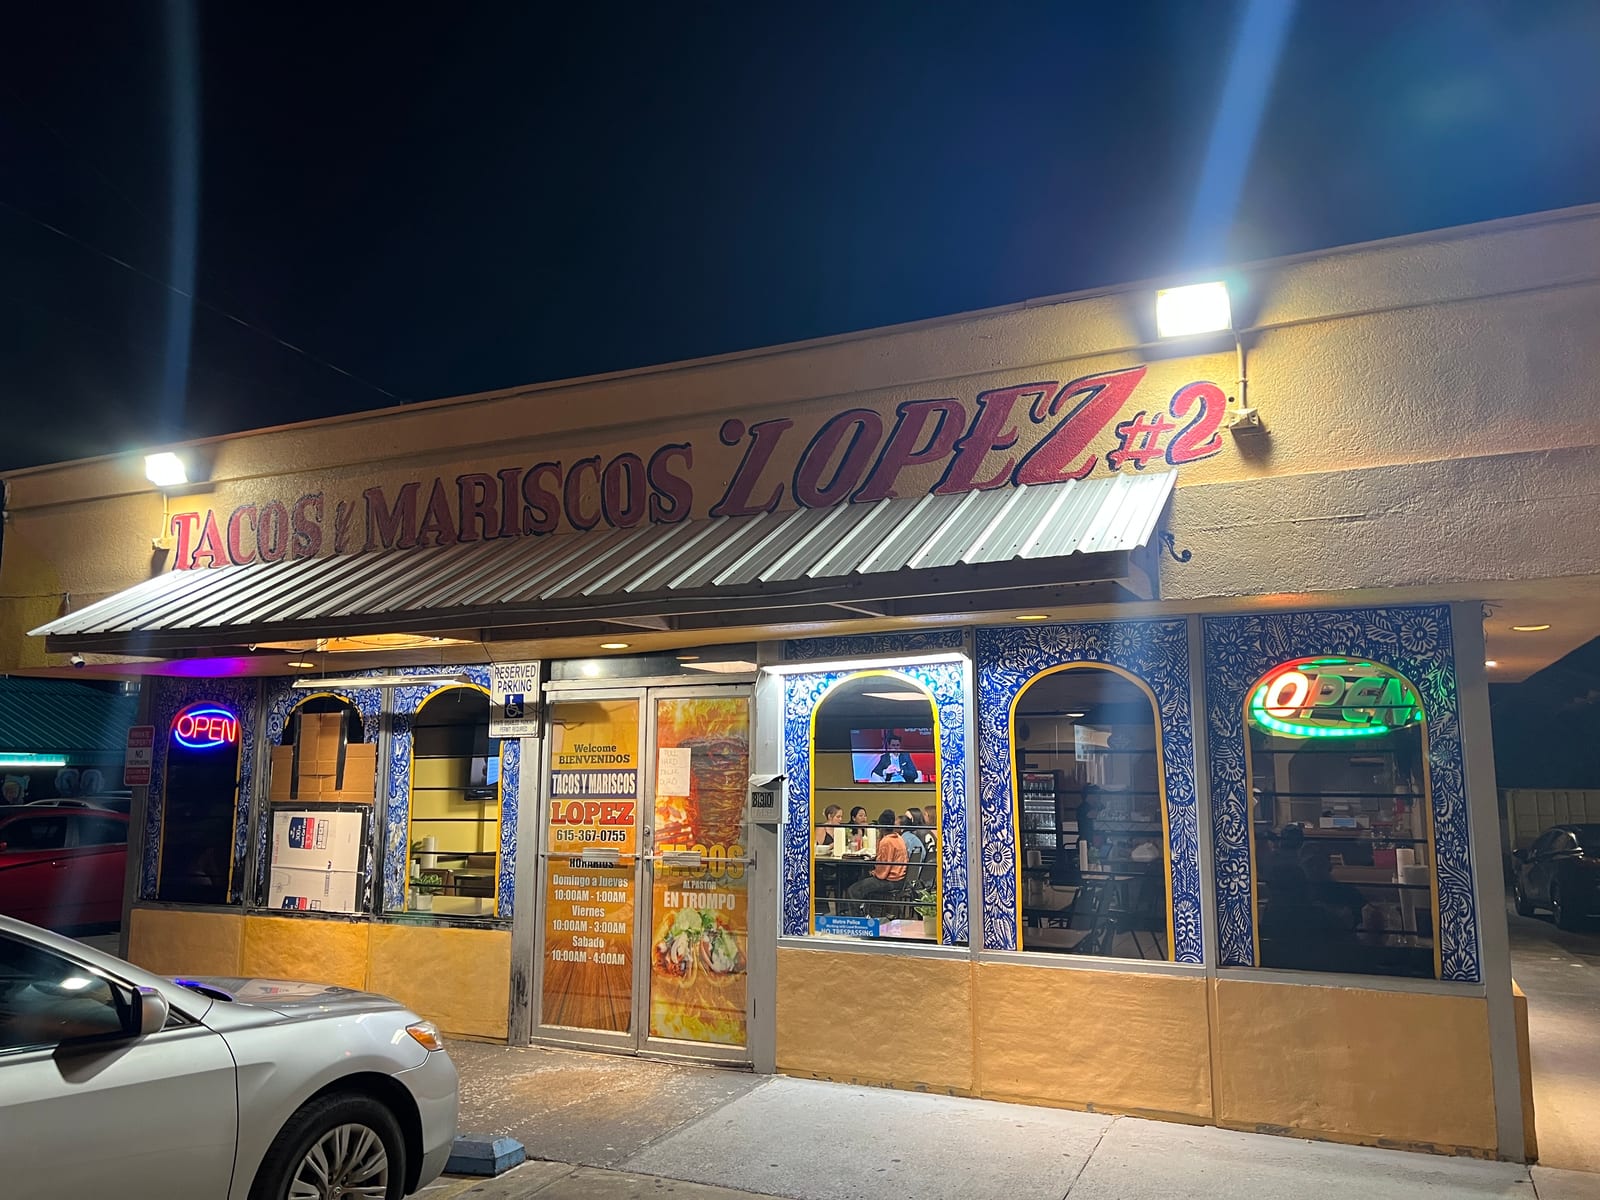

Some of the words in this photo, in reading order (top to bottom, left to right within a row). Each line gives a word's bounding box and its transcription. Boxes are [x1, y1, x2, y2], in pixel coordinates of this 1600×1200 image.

[170, 489, 324, 571] TACOS
[363, 442, 695, 552] MARISCOS
[708, 364, 1148, 518] LOPEZ
[1106, 380, 1228, 471] #2
[494, 665, 537, 679] RESERVED
[497, 679, 532, 693] PARKING
[1265, 671, 1416, 726] OPEN
[177, 715, 237, 743] OPEN
[574, 744, 617, 753] Welcome
[559, 754, 631, 765] BIENVENIDOS
[552, 773, 580, 795] TACOS
[581, 773, 588, 794] Y
[588, 773, 636, 795] MARISCOS
[550, 801, 636, 826] LOPEZ
[556, 829, 626, 842] 615-367-0755
[552, 874, 590, 887] Domingo
[591, 877, 598, 887] a
[598, 876, 629, 888] Jueves
[683, 880, 691, 889] AL
[691, 881, 717, 890] PASTOR
[554, 889, 590, 902] 10:00AM
[595, 891, 626, 903] 1:00AM
[663, 891, 679, 908] EN
[681, 892, 736, 911] TROMPO
[571, 904, 605, 918] Viernes
[552, 919, 588, 932] 10:00AM
[593, 921, 626, 934] 3:00AM
[832, 928, 874, 937] TRESPASSING
[572, 935, 605, 949] Sabado
[551, 949, 587, 963] 10:00AM
[593, 952, 626, 966] 4:00AM
